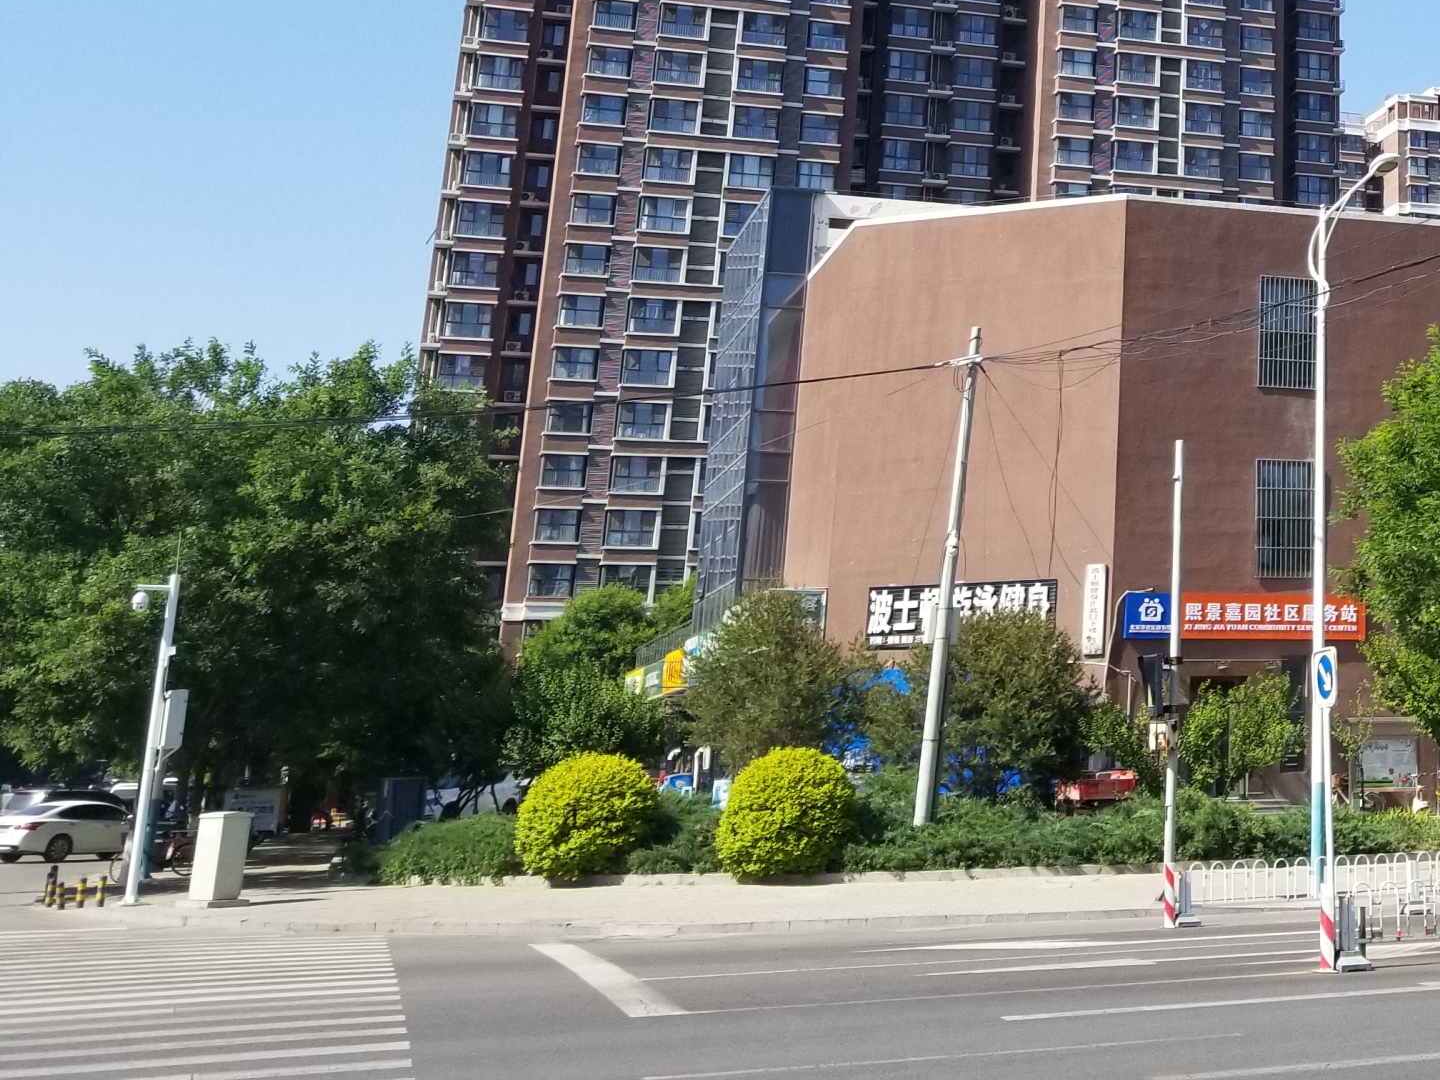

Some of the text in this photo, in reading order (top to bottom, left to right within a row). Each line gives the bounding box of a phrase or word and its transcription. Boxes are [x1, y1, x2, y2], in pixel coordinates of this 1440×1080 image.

[1184, 602, 1358, 623] 熙景嘉园社区服务站
